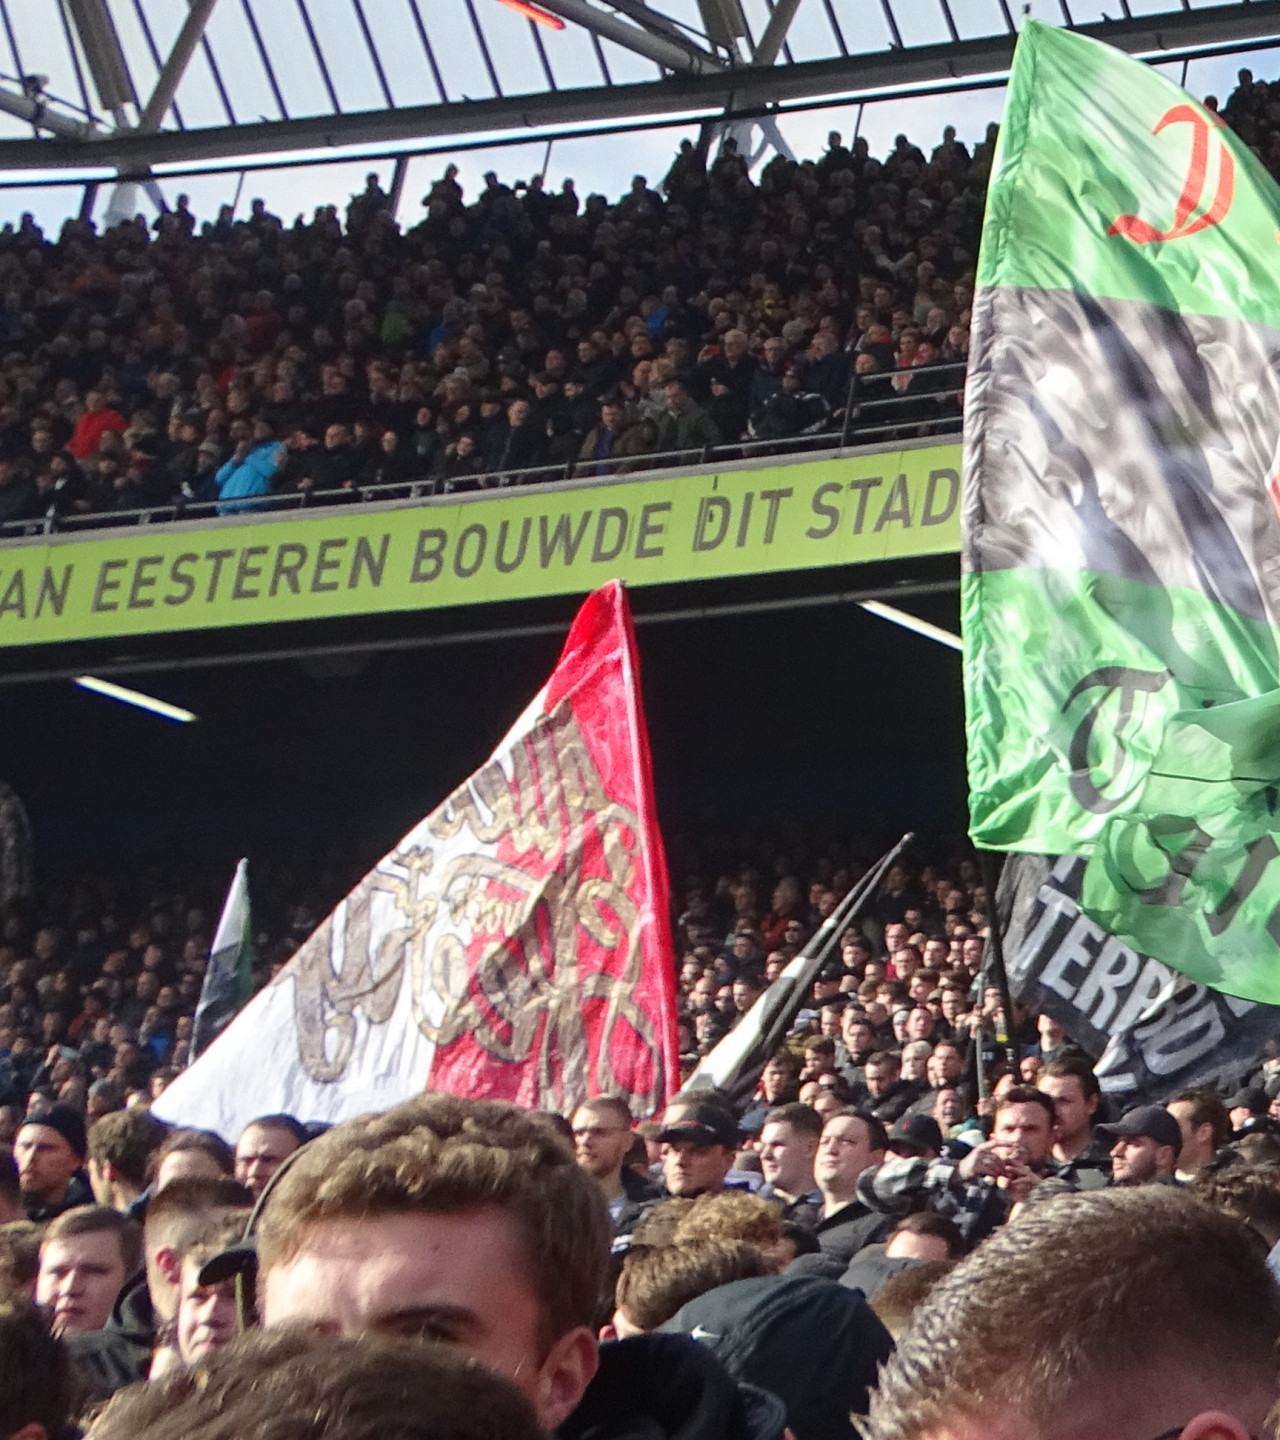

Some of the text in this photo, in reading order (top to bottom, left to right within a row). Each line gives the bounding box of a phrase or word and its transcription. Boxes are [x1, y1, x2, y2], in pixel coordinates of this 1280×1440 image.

[0, 467, 960, 619] AN EESTEREN BOUWDE DIT STAD
